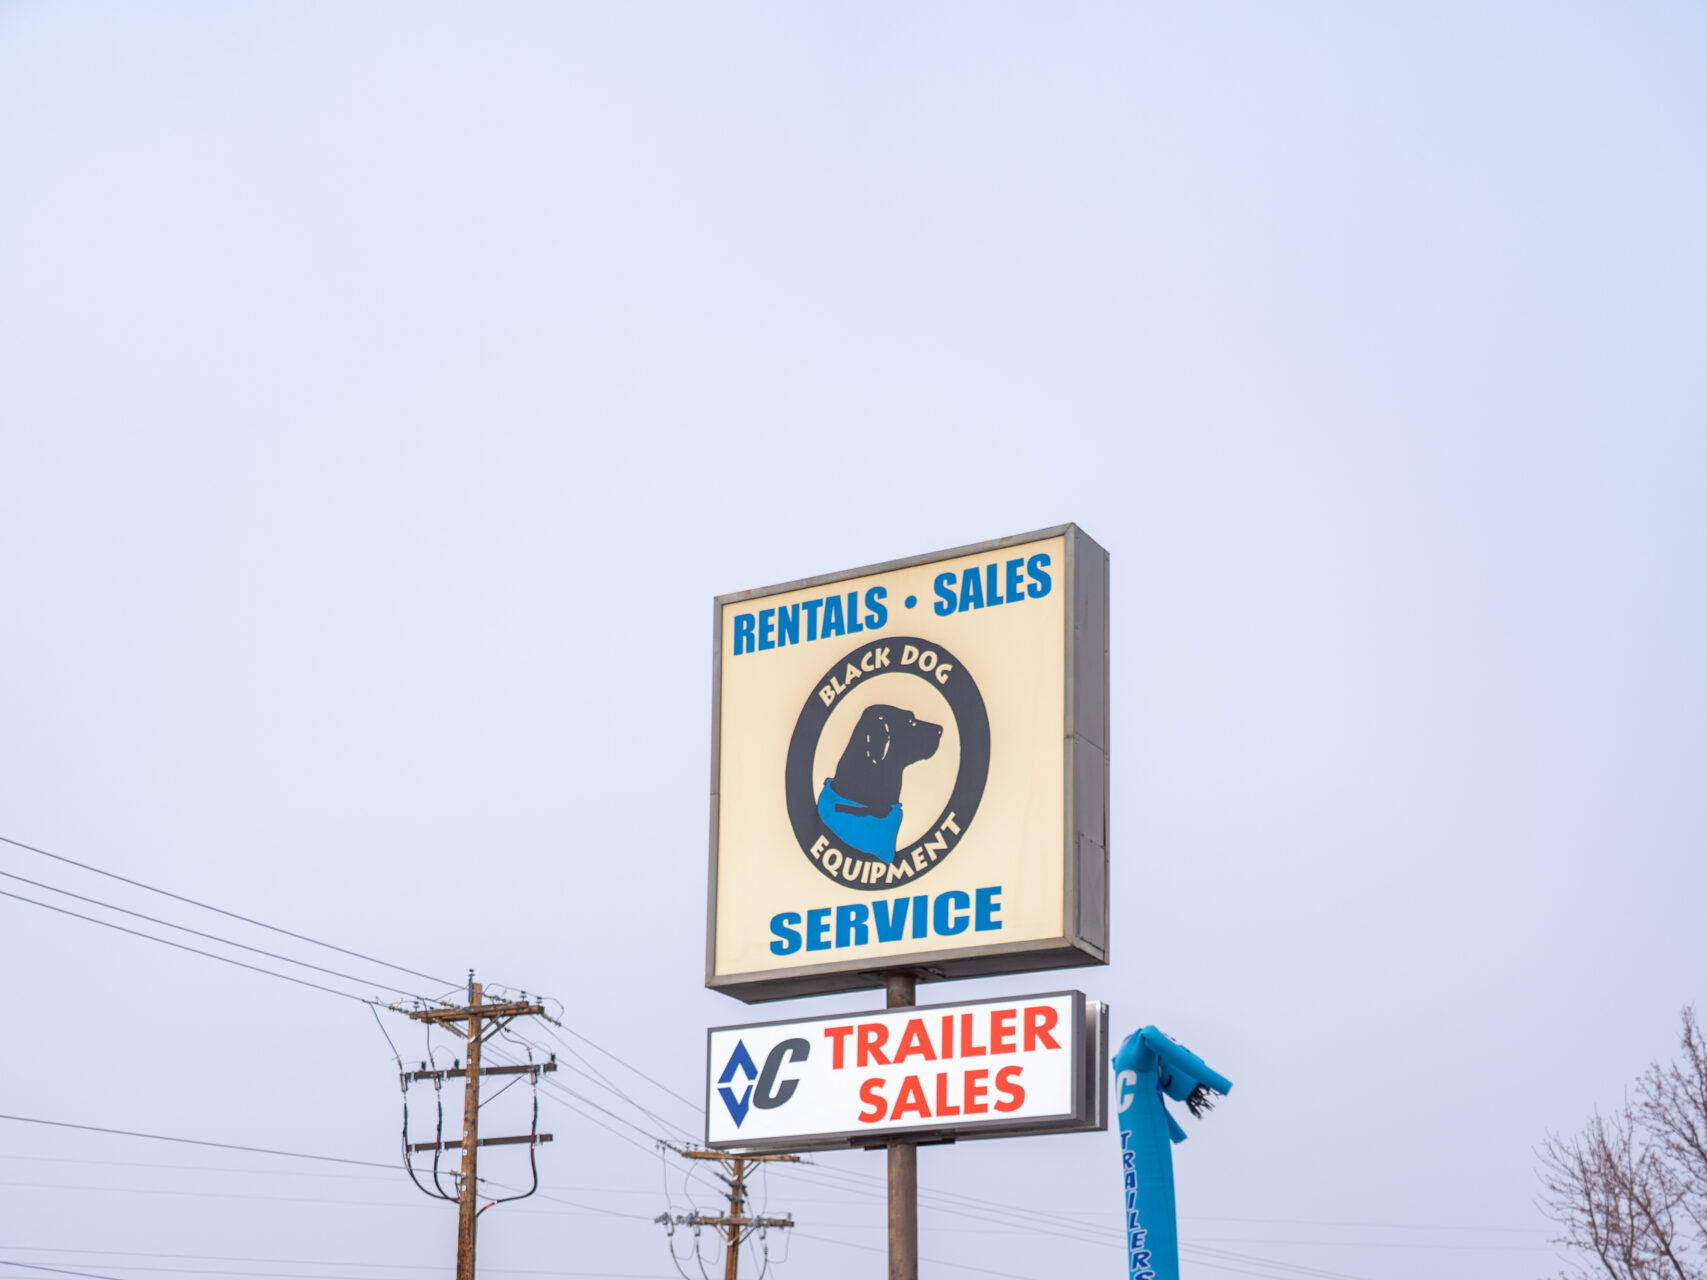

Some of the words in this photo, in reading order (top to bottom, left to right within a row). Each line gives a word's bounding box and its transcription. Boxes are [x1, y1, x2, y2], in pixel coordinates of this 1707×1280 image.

[733, 585, 888, 656] RENTALS
[933, 553, 1052, 617] SALES
[818, 647, 891, 707] BLACK
[901, 644, 953, 684] DOG
[809, 811, 963, 885] EQUIPMENT
[769, 886, 1002, 956] SERVICE
[824, 1005, 1062, 1070] TRAILER
[857, 1065, 1026, 1124] SALES
